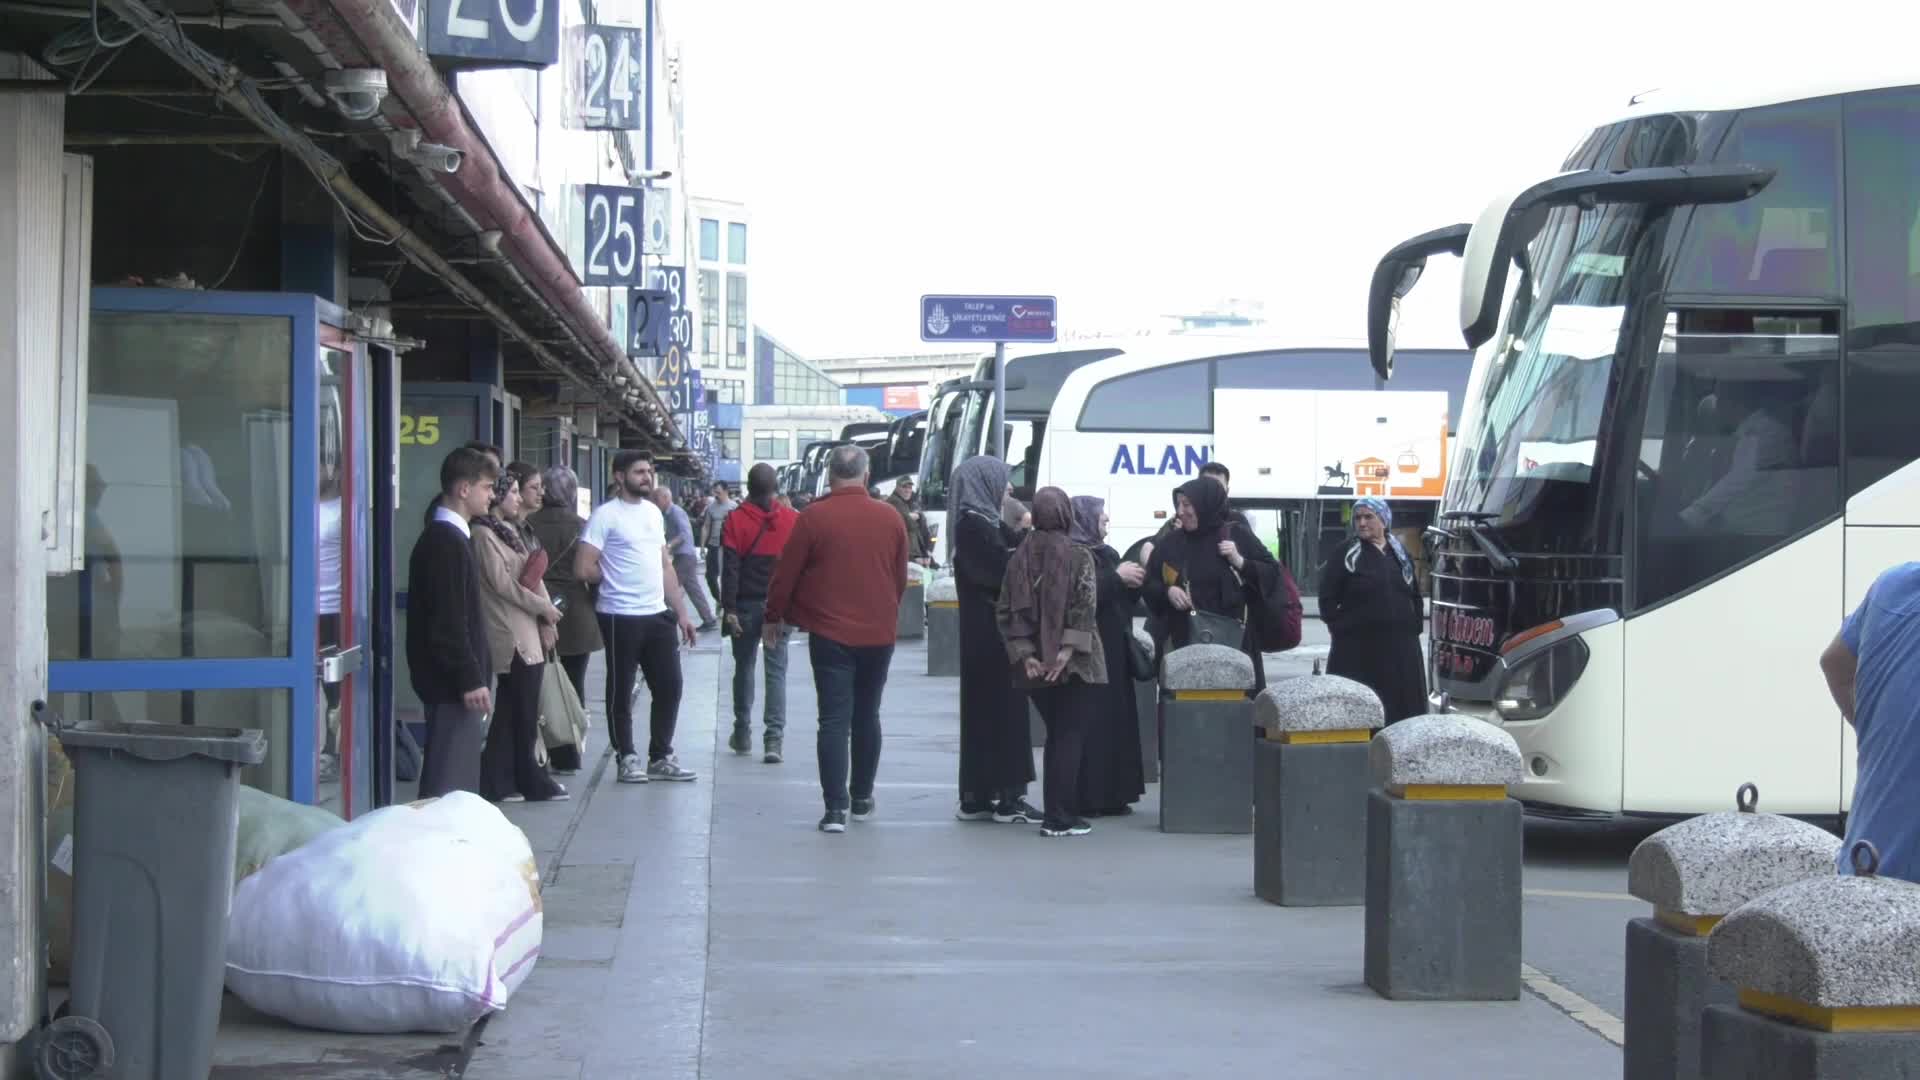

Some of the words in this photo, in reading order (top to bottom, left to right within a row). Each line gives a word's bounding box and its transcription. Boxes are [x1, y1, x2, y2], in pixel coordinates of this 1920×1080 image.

[585, 33, 632, 118] 24
[589, 195, 635, 276] 25
[669, 314, 690, 347] 30
[400, 416, 440, 445] 25
[1110, 444, 1214, 475] ALAN
